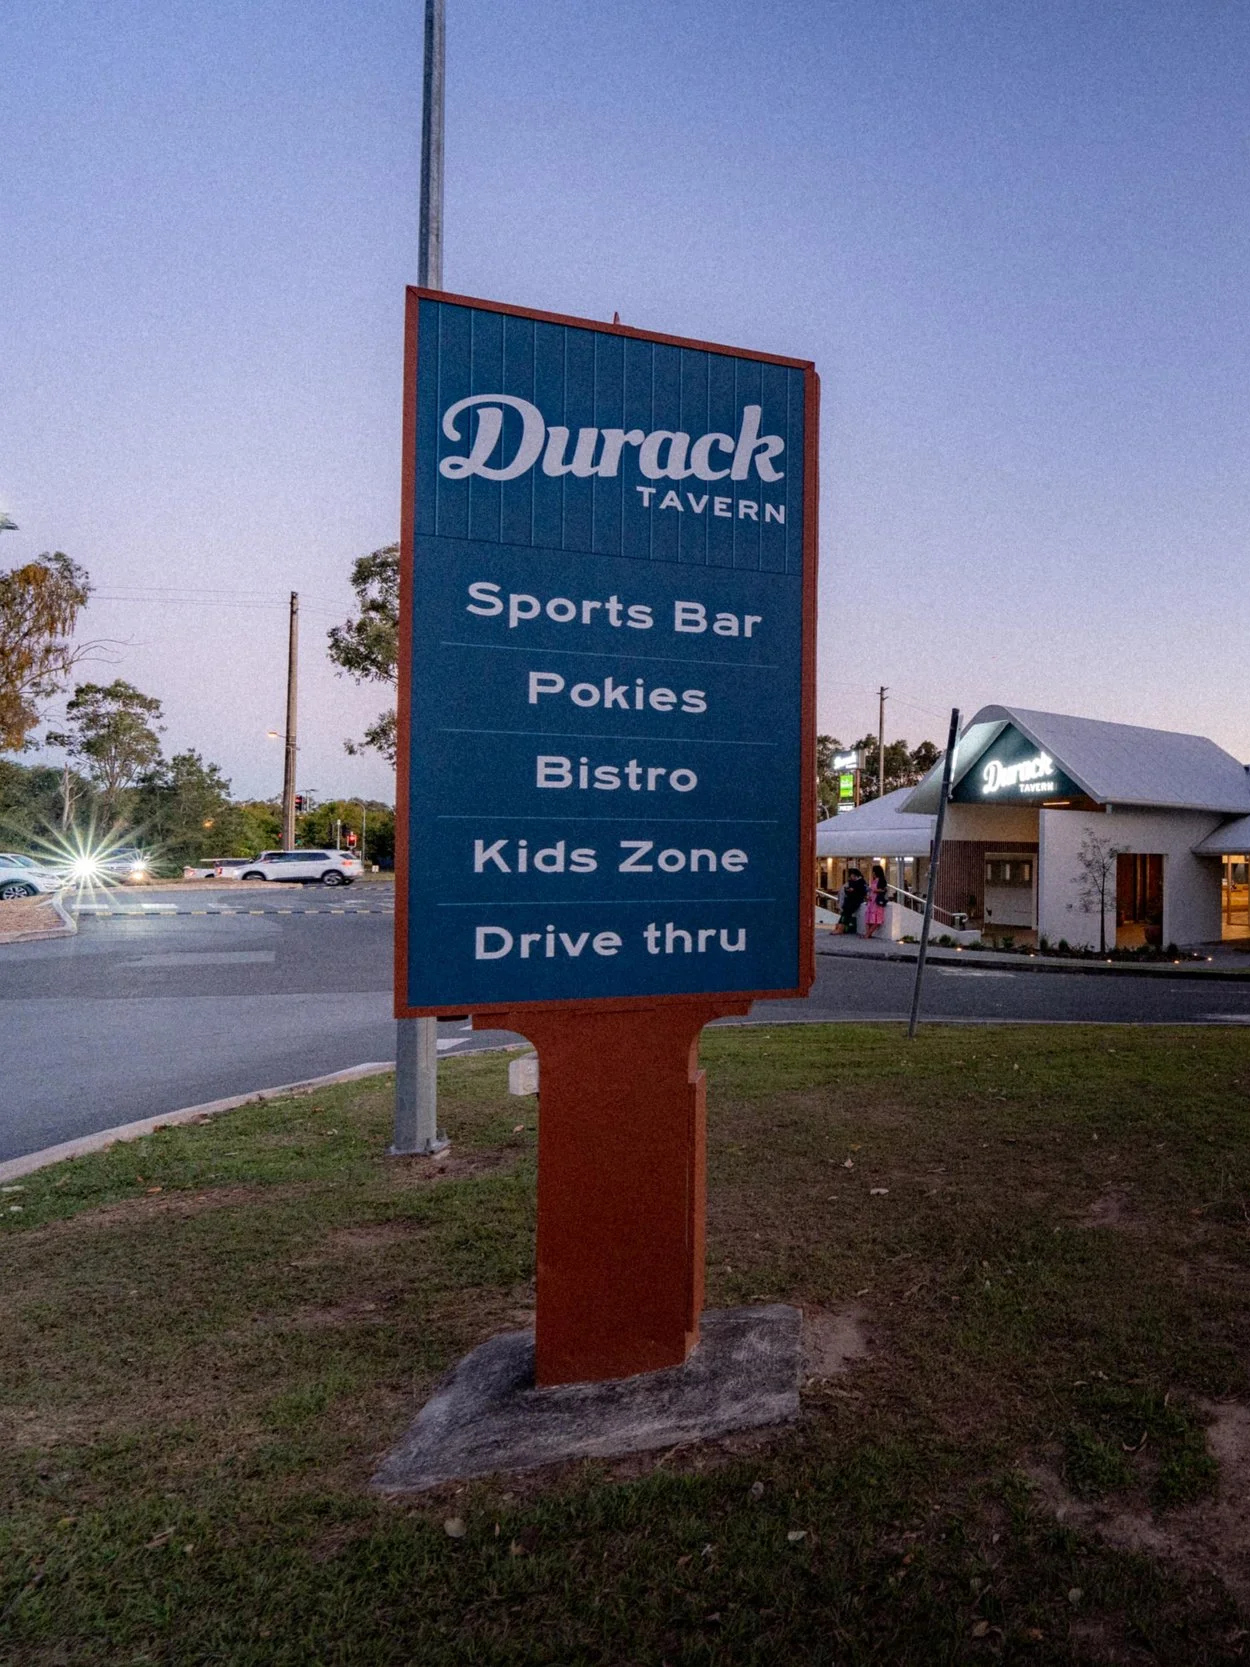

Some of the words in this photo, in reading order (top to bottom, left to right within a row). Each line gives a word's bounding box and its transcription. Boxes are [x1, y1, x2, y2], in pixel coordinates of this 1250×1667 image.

[439, 393, 786, 483] Durack
[636, 485, 787, 525] TAVERN
[466, 581, 655, 630] Sports
[674, 600, 763, 638] Bar
[528, 671, 708, 714] Pokies
[536, 755, 699, 793] Bistro
[1019, 781, 1054, 793] TAVERN
[474, 839, 598, 873] Kids
[618, 840, 749, 873] Zone
[475, 924, 623, 960] Drive
[643, 922, 747, 955] thru
